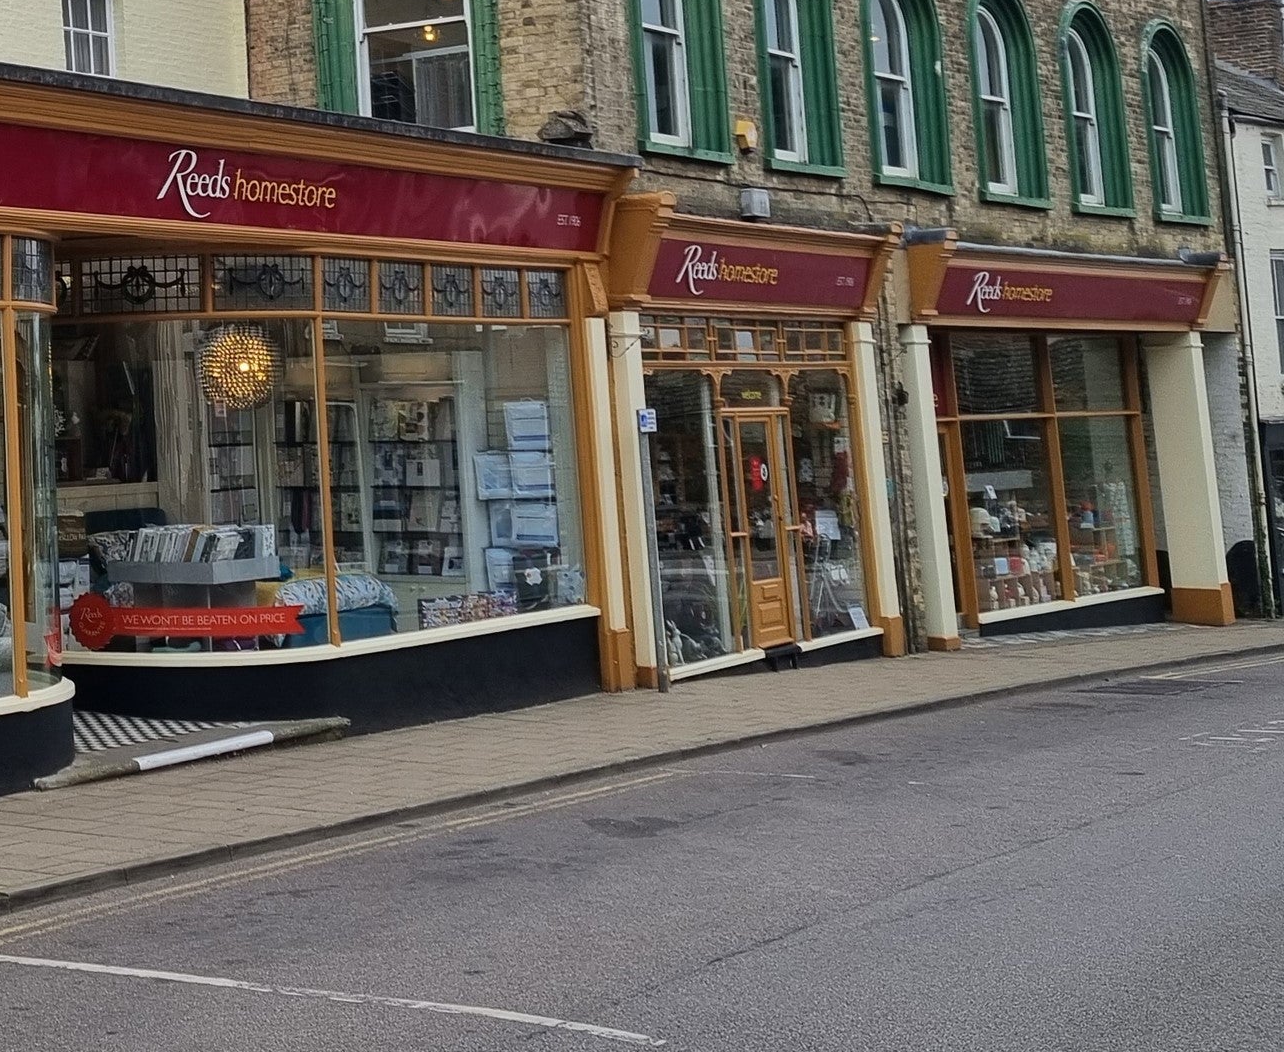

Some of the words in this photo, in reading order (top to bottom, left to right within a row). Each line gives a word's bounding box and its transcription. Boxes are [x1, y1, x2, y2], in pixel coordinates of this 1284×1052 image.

[156, 149, 231, 218] Reeds
[233, 169, 337, 208] homestore
[676, 245, 719, 295] Reeds
[719, 257, 779, 285] homestore
[966, 271, 1002, 313] Reeds
[1002, 281, 1053, 302] homestore
[121, 614, 139, 624] WE
[140, 614, 179, 625] WON'T
[182, 615, 194, 625] BE
[197, 614, 237, 625] BEATEN
[240, 613, 258, 624] ON
[260, 613, 285, 623] PRICE
